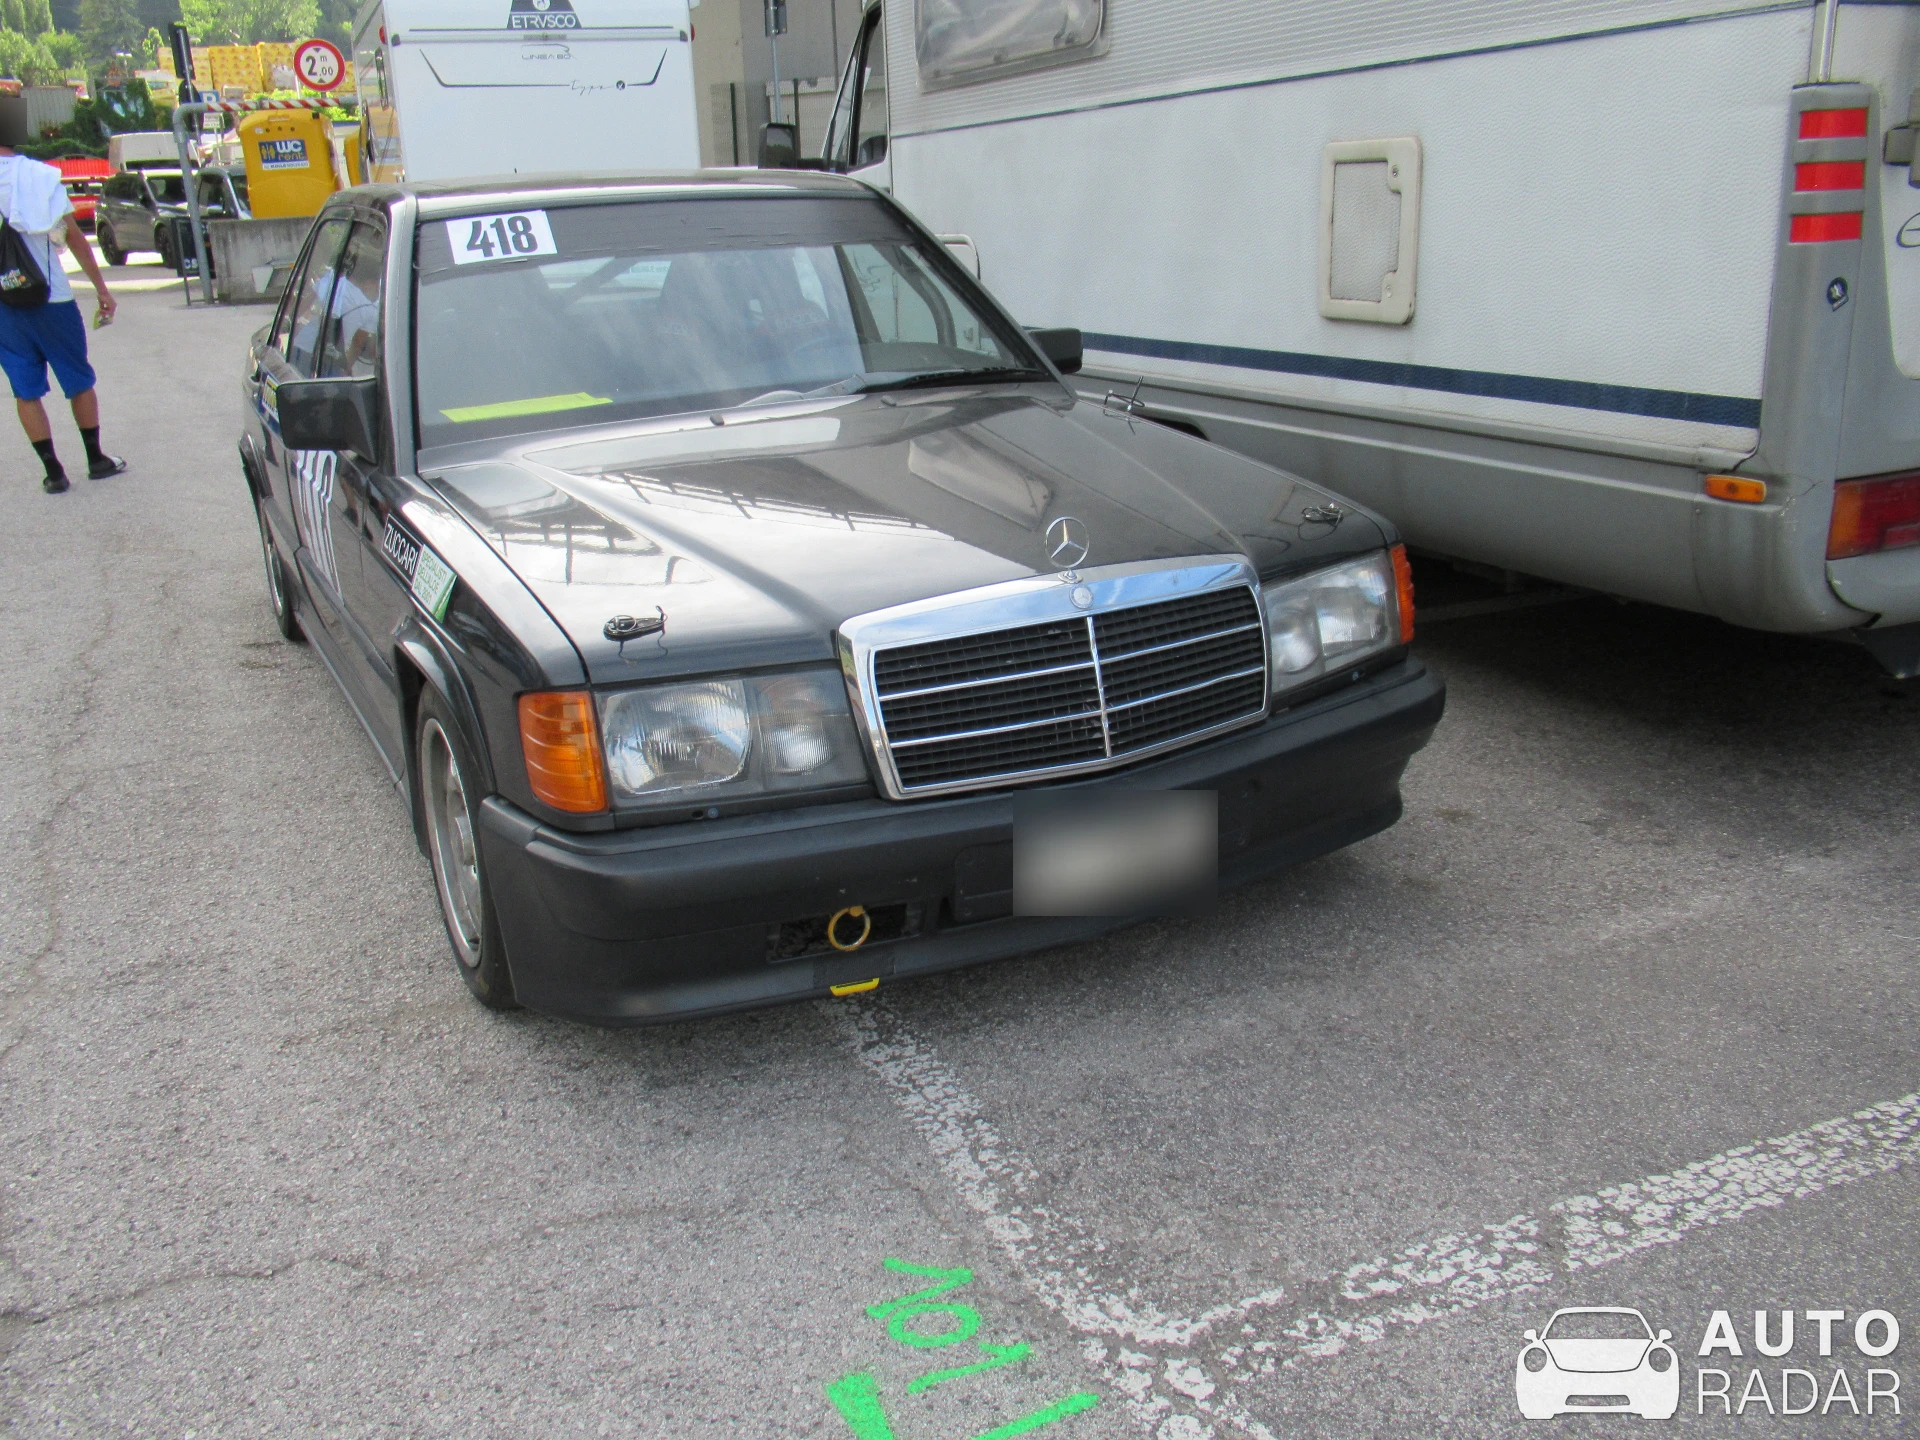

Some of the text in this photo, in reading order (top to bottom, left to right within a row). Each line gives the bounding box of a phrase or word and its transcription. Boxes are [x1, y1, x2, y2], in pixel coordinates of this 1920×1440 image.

[275, 140, 303, 154] WC
[466, 215, 538, 258] 418
[383, 522, 419, 576] ZUCCARI
